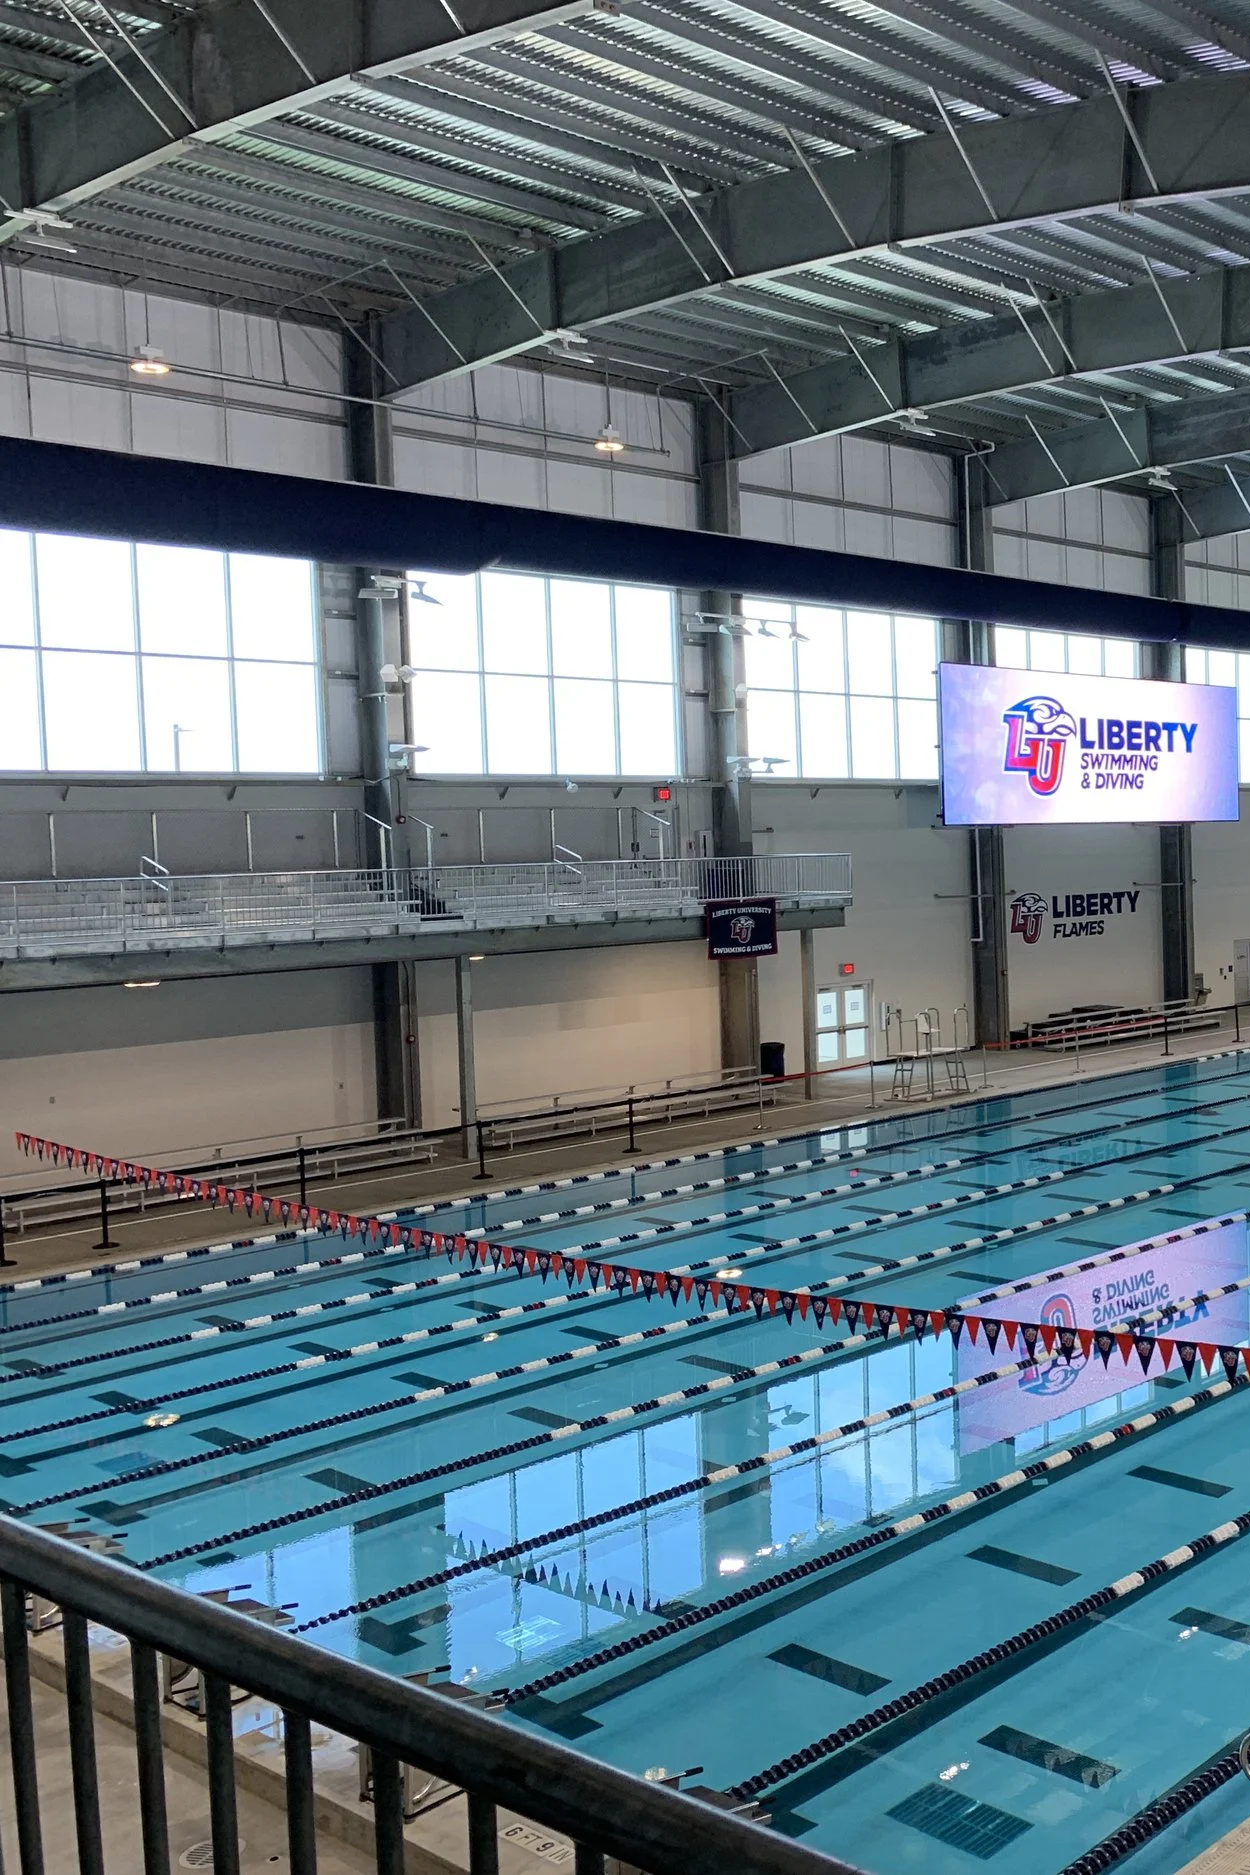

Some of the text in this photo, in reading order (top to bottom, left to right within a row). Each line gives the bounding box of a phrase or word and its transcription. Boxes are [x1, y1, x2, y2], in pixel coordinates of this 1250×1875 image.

[1079, 717, 1198, 753] LIBERTY
[1080, 752, 1159, 771] SWIMMING
[1081, 772, 1145, 790] & DIVING
[712, 908, 736, 918] LIBERTY
[1052, 890, 1140, 918] LIBERTY
[1053, 920, 1104, 938] FLAMES
[505, 1827, 573, 1861] 6 FT 9 IN
